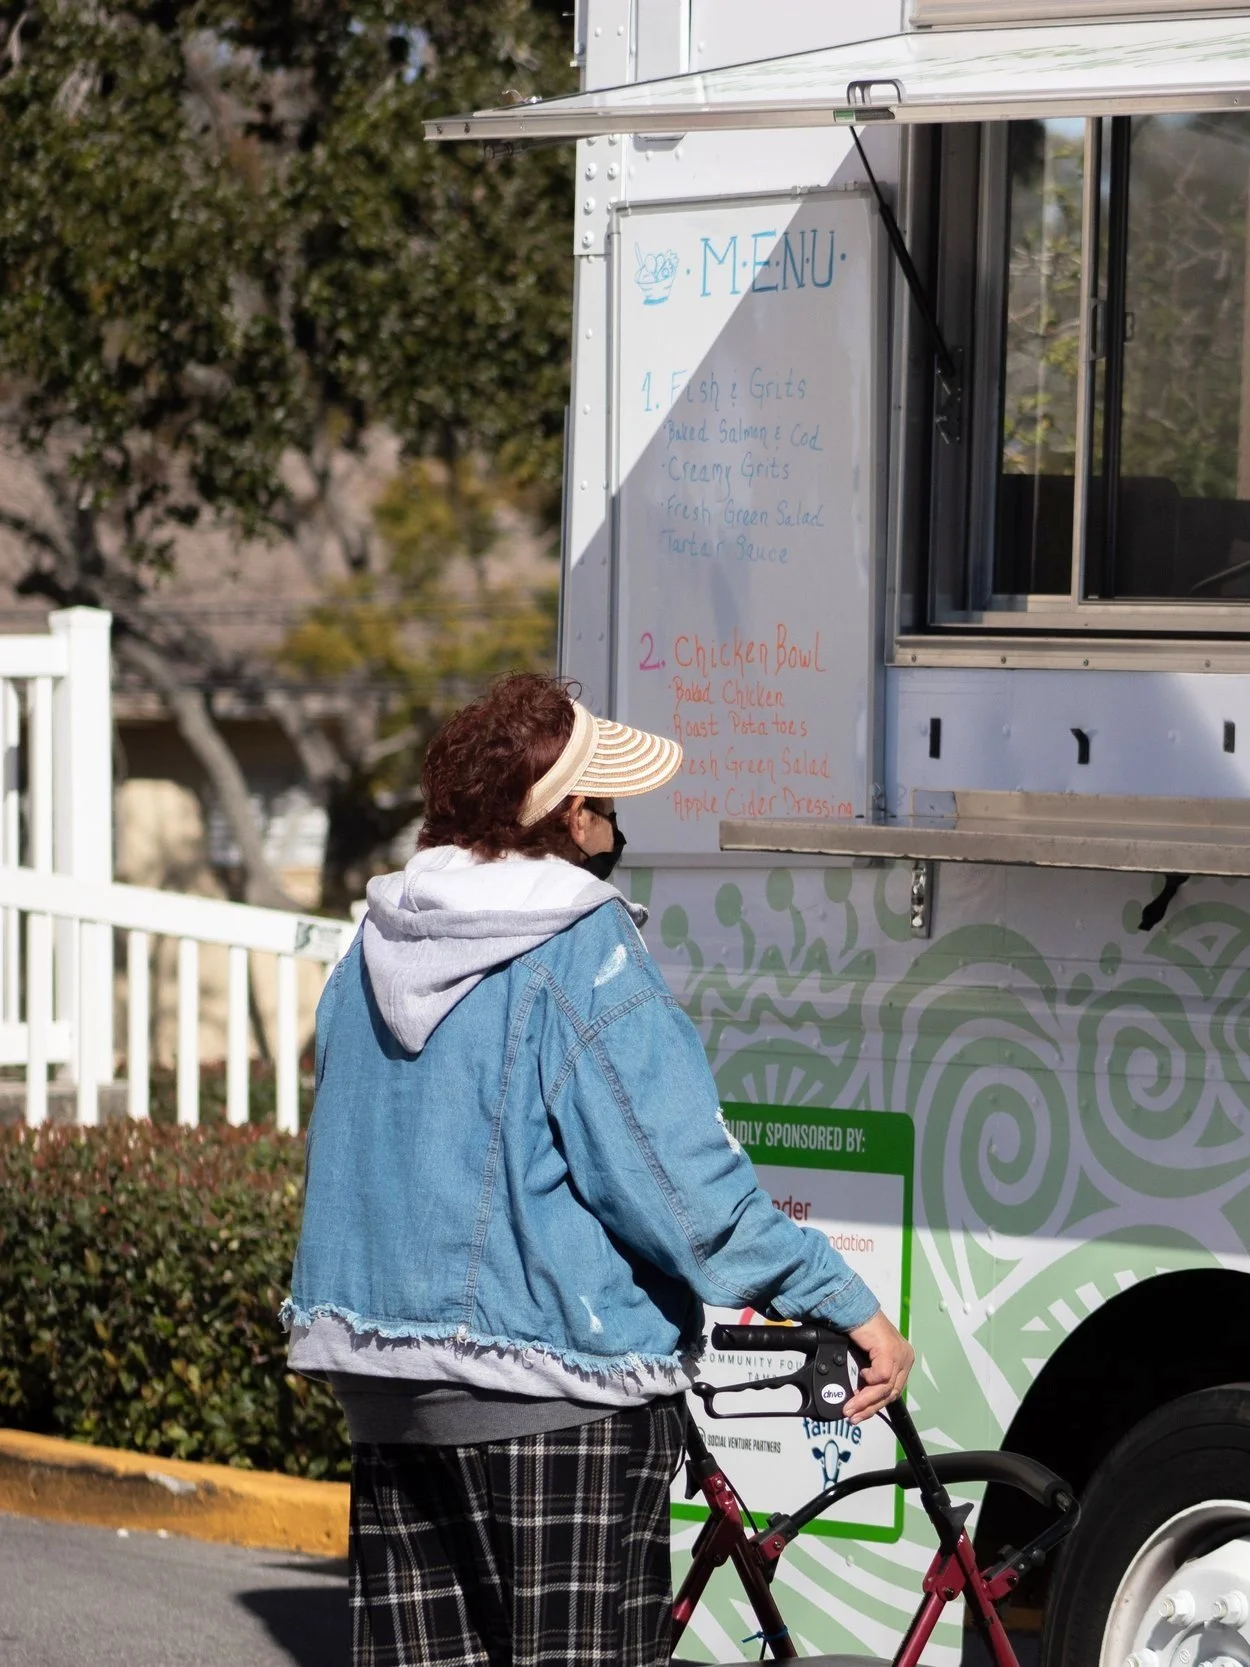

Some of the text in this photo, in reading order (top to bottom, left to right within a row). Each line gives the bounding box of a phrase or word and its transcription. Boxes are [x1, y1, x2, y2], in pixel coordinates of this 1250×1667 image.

[641, 371, 660, 412] 1.
[671, 369, 720, 411] Fish
[750, 367, 807, 406] Grits
[719, 418, 769, 449] Salmon
[790, 424, 824, 452] Cod
[667, 451, 791, 502] Creamy Grits
[667, 495, 826, 528] Fresh Green Salad
[639, 623, 827, 678] 2. Chicken Bowl
[721, 680, 785, 709] Chicken
[672, 710, 809, 744] Roast Potatoes
[680, 746, 832, 784] resh Green Salad
[673, 790, 719, 821] Apple
[724, 786, 777, 818] Cider
[765, 1122, 842, 1151] SPONSORED
[845, 1127, 866, 1153] BY:
[823, 1390, 844, 1399] drive
[707, 1433, 782, 1454] SOCIAL VENTURE PARTNERS
